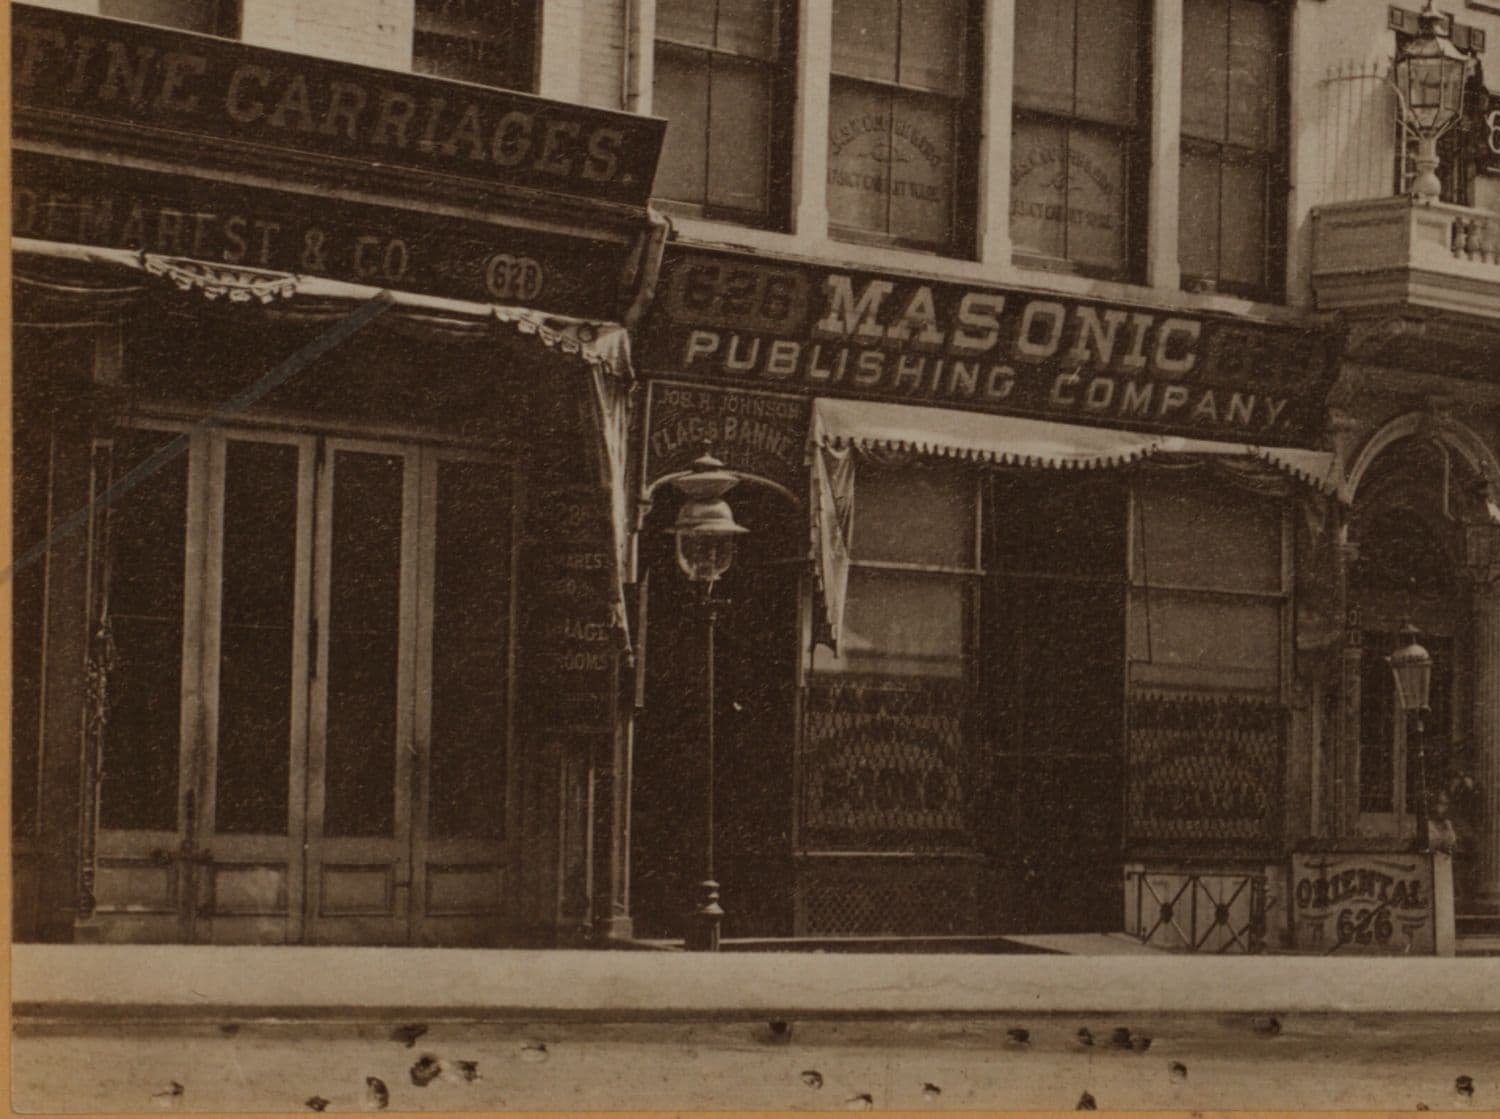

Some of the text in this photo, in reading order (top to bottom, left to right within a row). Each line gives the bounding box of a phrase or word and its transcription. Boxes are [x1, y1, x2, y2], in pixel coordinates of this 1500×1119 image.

[14, 24, 635, 185] FINE CARRIAGES.
[15, 186, 282, 266] DEMAREST
[301, 228, 328, 275] &
[816, 274, 1202, 374] MASONIC
[685, 330, 1294, 429] PUBLISHING COMPANY.
[1336, 909, 1394, 945] 626
